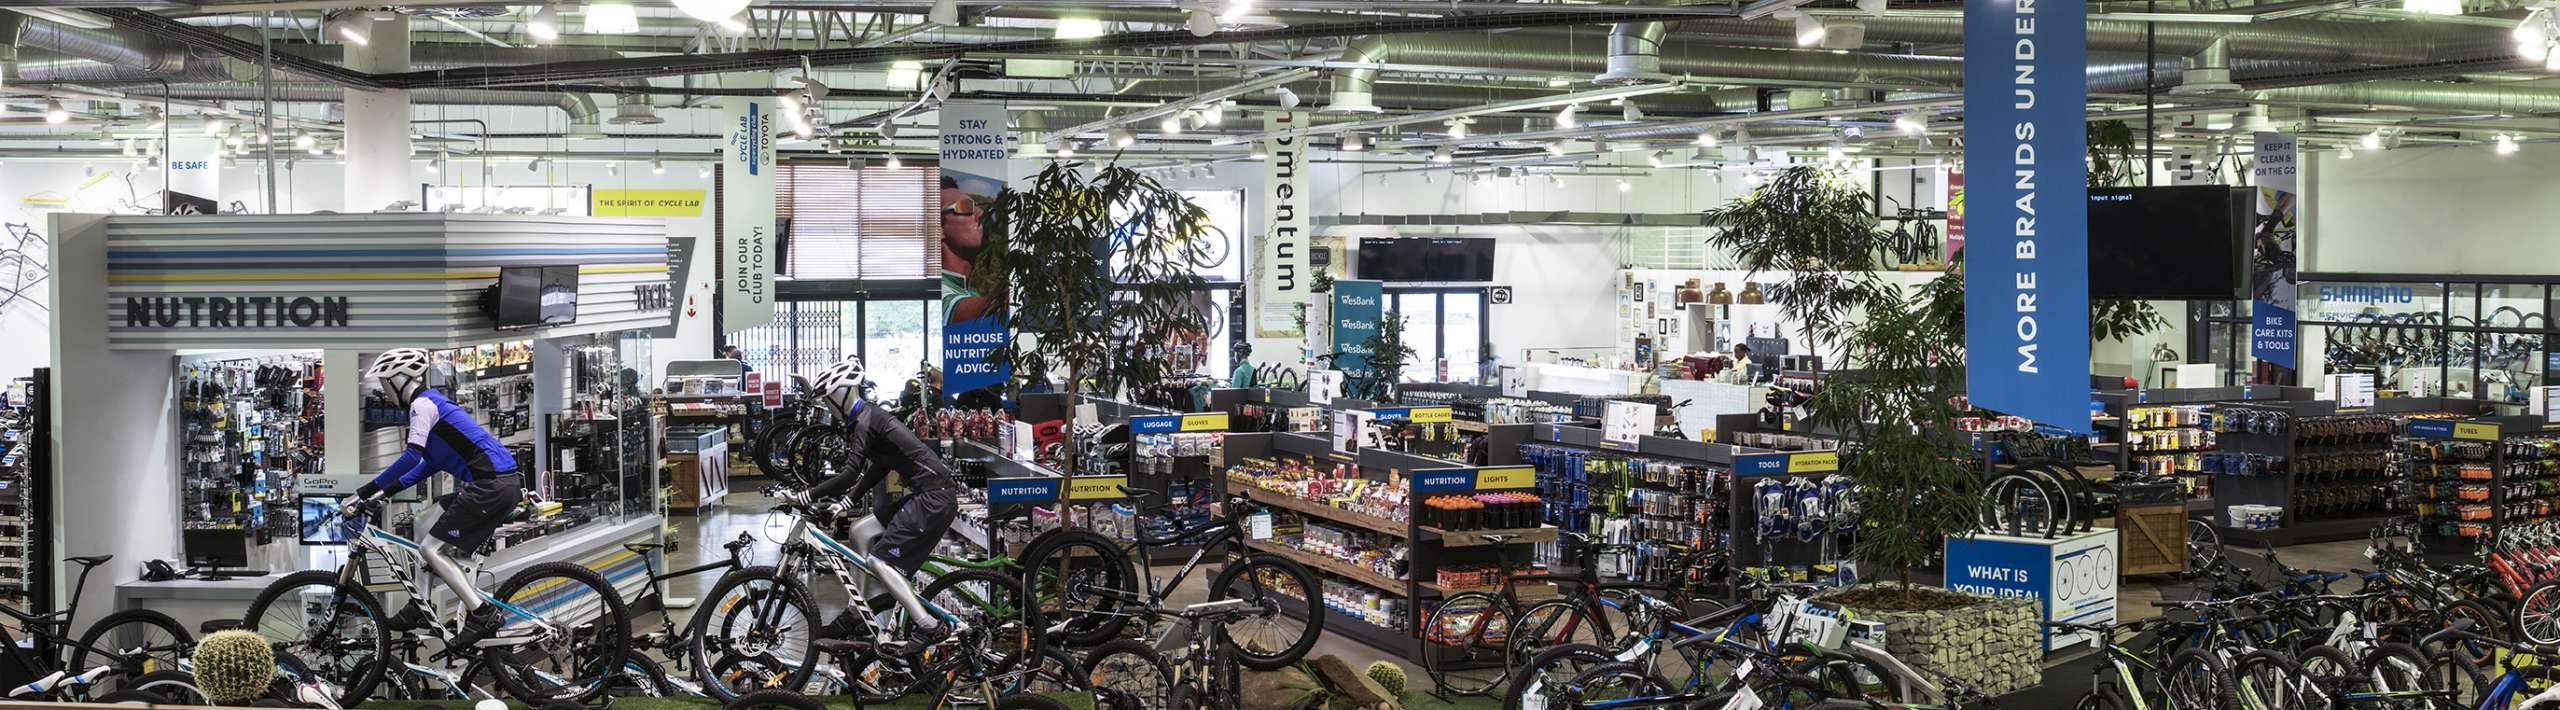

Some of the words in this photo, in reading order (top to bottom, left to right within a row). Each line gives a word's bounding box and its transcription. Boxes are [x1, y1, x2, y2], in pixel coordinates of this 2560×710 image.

[2015, 0, 2036, 110] UNDER
[740, 115, 748, 133] LAB
[959, 119, 988, 130] STAY
[761, 113, 769, 150] TOYOTA
[943, 134, 992, 145] STRONG
[995, 134, 1003, 145] &
[740, 134, 748, 162] CYCLE
[2263, 143, 2283, 152] KEEP
[942, 149, 1005, 160] HYDRATED
[2260, 155, 2284, 164] CLEAN
[171, 161, 185, 170] BE
[186, 161, 209, 170] SAFE
[2255, 167, 2267, 176] ON
[2268, 167, 2283, 176] THE
[2284, 166, 2296, 175] GO
[2015, 120, 2036, 260] BRANDS
[1276, 111, 1297, 291] omentum
[2090, 194, 2108, 202] input
[2111, 193, 2132, 202] signal
[738, 238, 748, 264] OUR
[752, 226, 763, 270] TODAY!
[738, 266, 750, 294] JOIN
[752, 273, 763, 304] CLUB
[634, 283, 667, 311] TECH
[1341, 294, 1375, 306] WesBank
[2319, 285, 2413, 305] SHIMANO
[126, 296, 348, 328] NUTRITION
[1341, 318, 1375, 330] WesBank
[2016, 271, 2039, 374] MORE
[2265, 316, 2283, 326] BIKE
[949, 334, 961, 345] IN
[964, 333, 1004, 344] HOUSE
[2255, 328, 2275, 337] CARE
[2276, 329, 2293, 338] KITS
[2264, 340, 2290, 350] TOOLS
[945, 348, 1006, 360] NUTRIT
[1340, 367, 1374, 378] WesBnk
[1143, 421, 1173, 429] LUGGAGE
[2460, 427, 2478, 435] TUBES
[1758, 461, 1780, 469] TOOLS
[1424, 476, 1466, 486] NUTRITION
[1483, 475, 1508, 484] LIGHTS
[1001, 486, 1048, 496] NUTRITION
[1967, 564, 2011, 582] WHAT
[2014, 569, 2028, 583] IS
